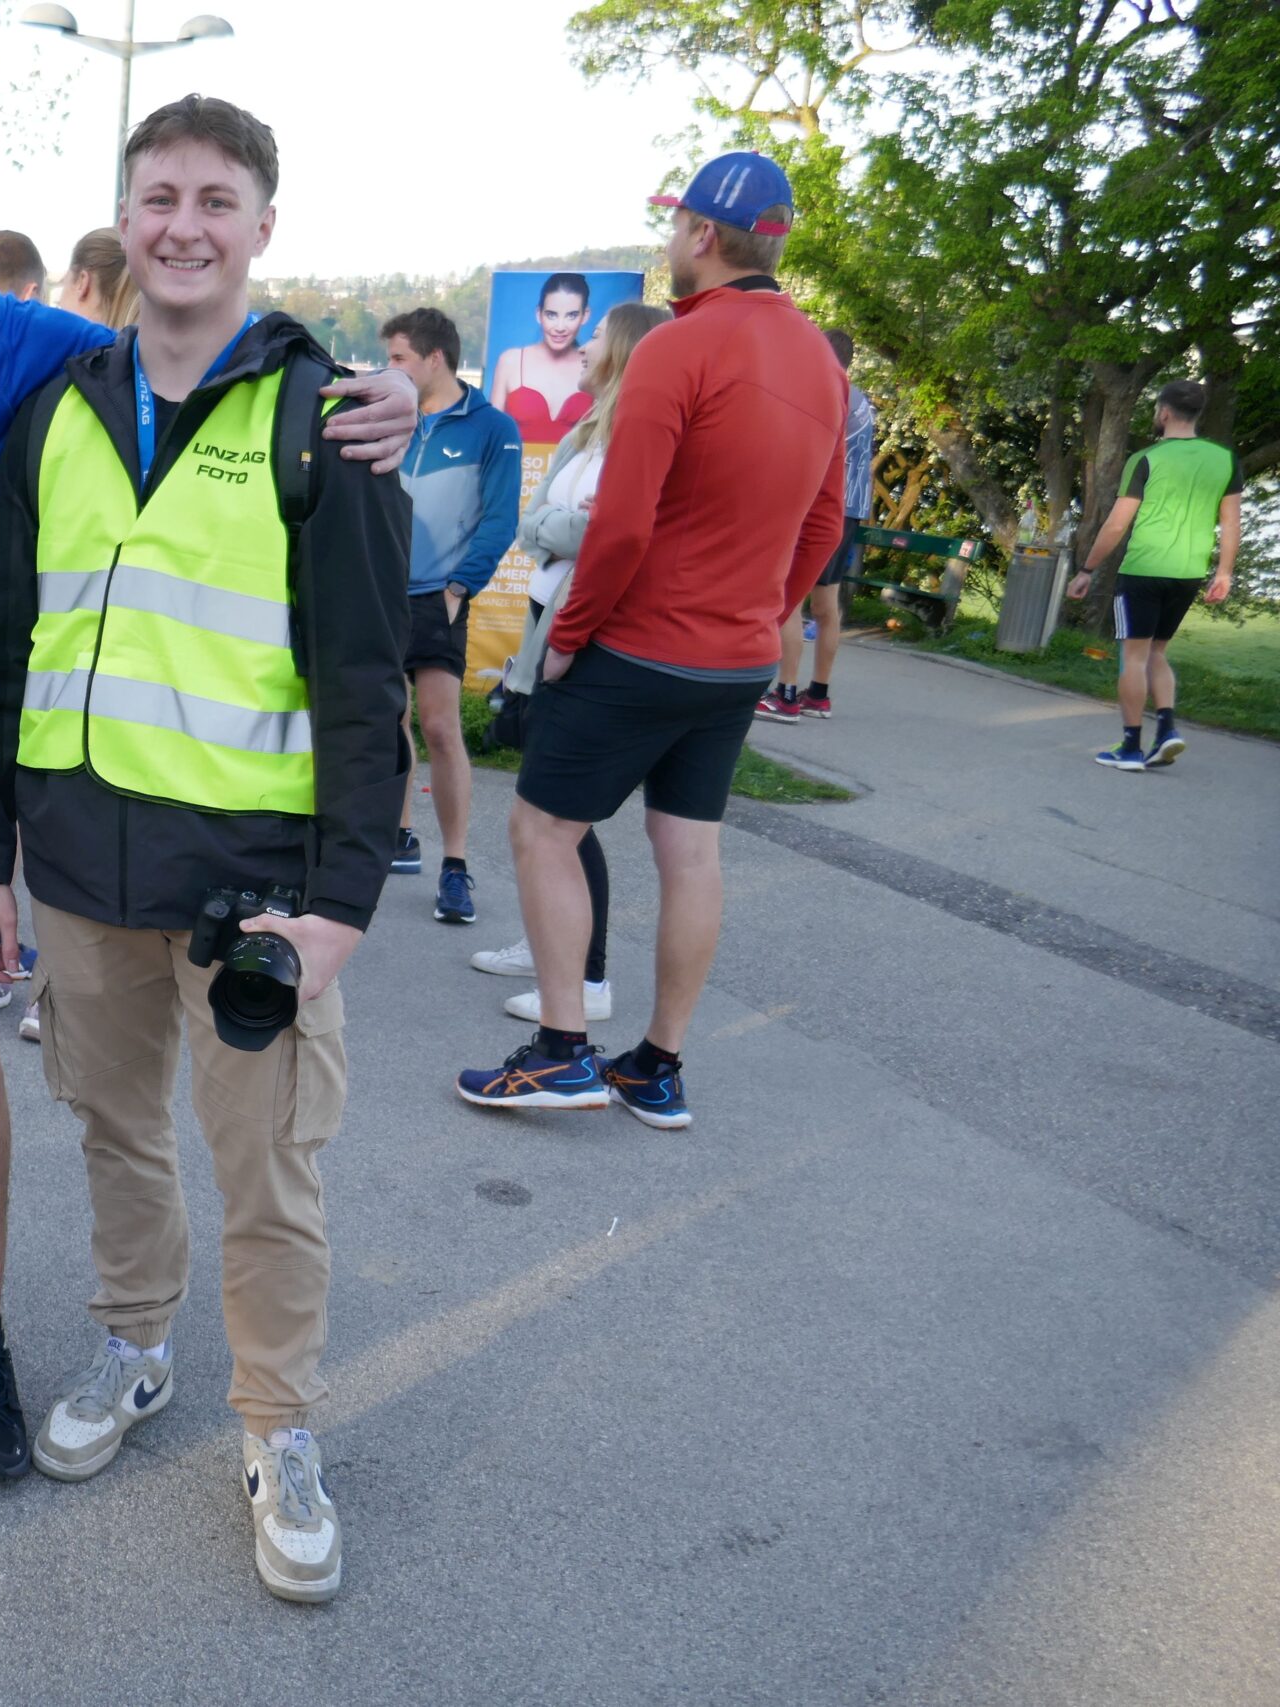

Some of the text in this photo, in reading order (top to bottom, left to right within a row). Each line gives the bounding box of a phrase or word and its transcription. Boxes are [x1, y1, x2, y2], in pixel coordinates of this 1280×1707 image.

[139, 373, 150, 426] LINZ AG
[192, 442, 267, 465] LINZ AG
[196, 464, 249, 485] FOTO
[266, 906, 290, 918] Canon
[107, 1337, 122, 1351] NIKE
[294, 1431, 309, 1442] NIKE
